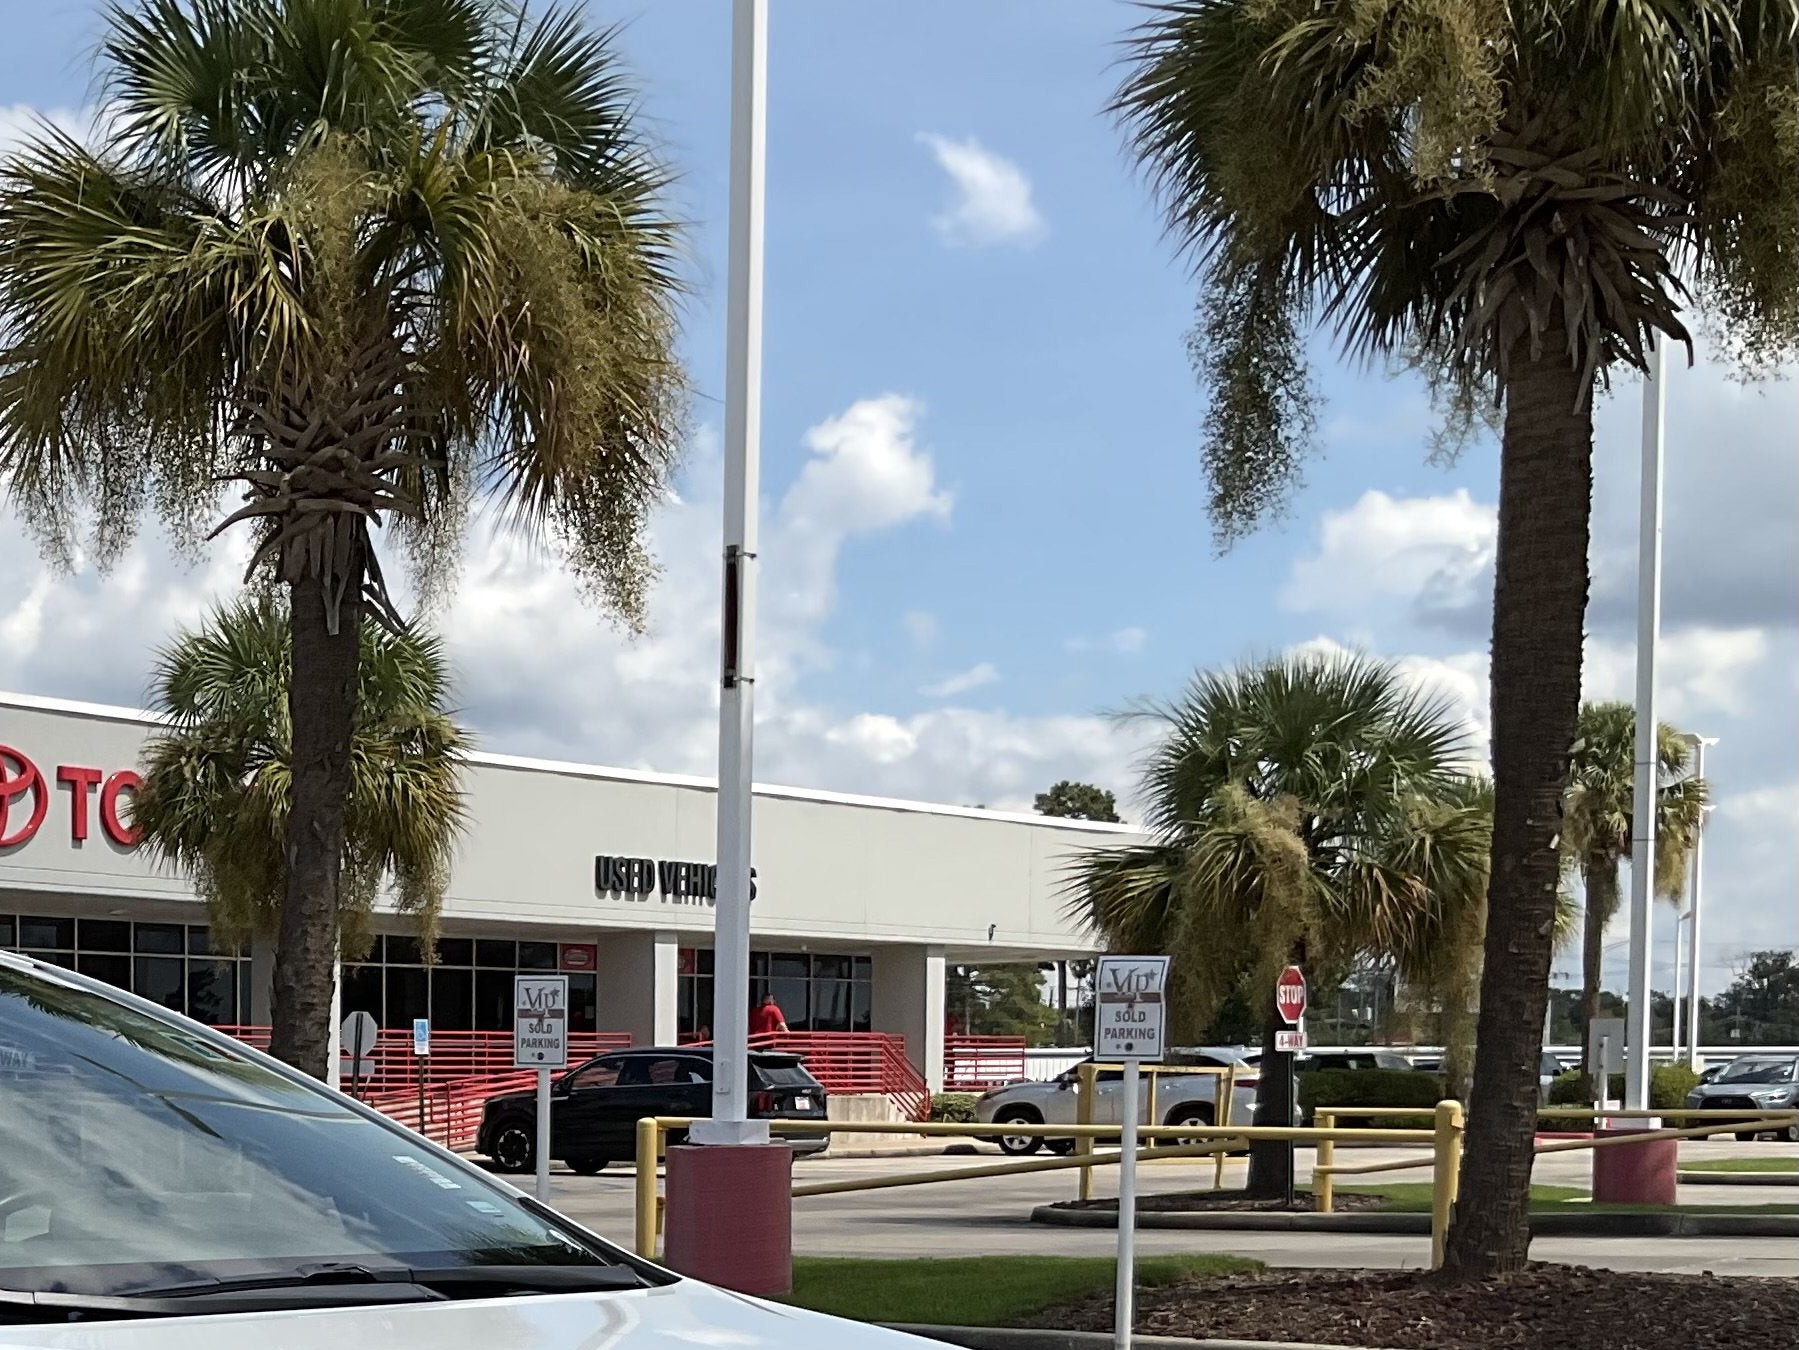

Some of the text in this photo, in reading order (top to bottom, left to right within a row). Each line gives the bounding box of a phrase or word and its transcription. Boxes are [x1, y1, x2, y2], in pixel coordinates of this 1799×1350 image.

[595, 855, 757, 901] USED VEHICS
[1280, 985, 1304, 1005] STOP
[1114, 1010, 1146, 1023] SOLD
[528, 1022, 553, 1034] SOLD
[1104, 1027, 1156, 1040] PARKING
[520, 1037, 560, 1049] PARKING
[1279, 1034, 1304, 1047] 4-WAY
